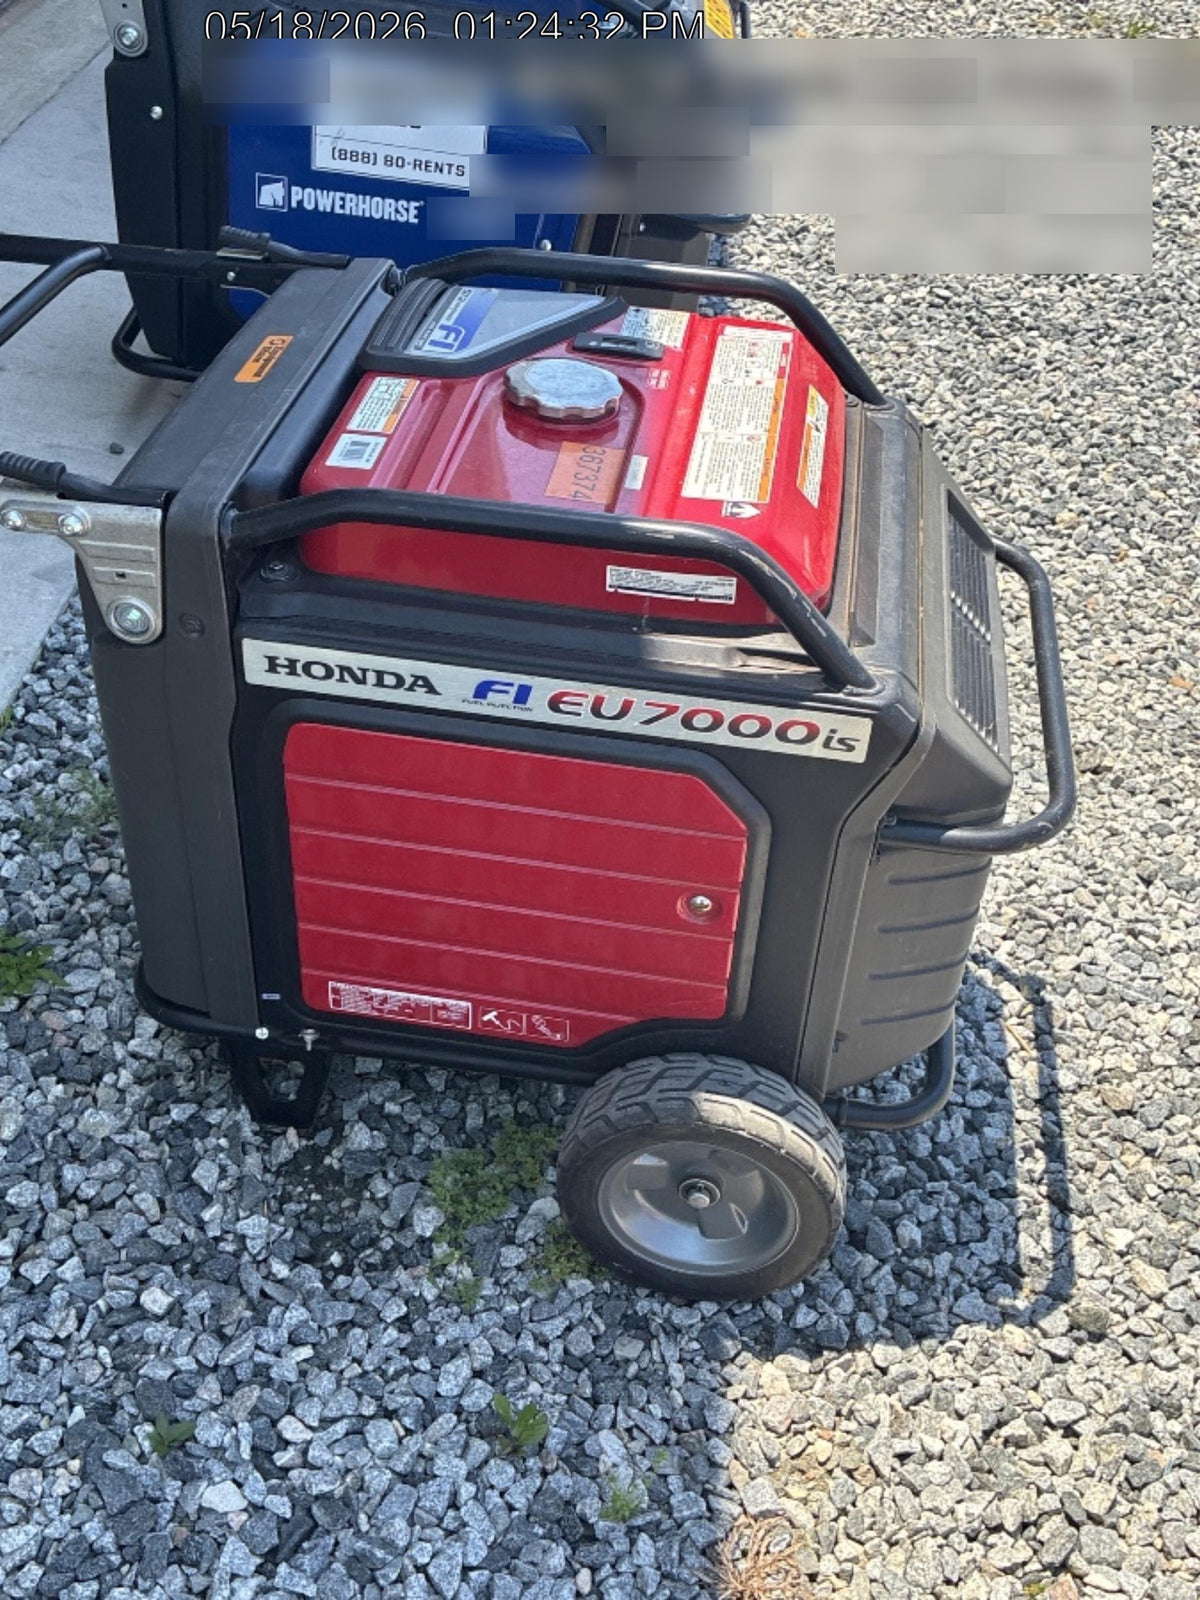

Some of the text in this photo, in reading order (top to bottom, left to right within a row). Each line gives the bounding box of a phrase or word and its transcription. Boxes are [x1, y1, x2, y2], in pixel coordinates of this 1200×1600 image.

[331, 146, 466, 178] (888) 80-RENTS
[290, 185, 420, 224] POWERHORSE
[571, 445, 607, 500] 367374
[263, 655, 443, 696] HONDA
[472, 680, 533, 705] FI
